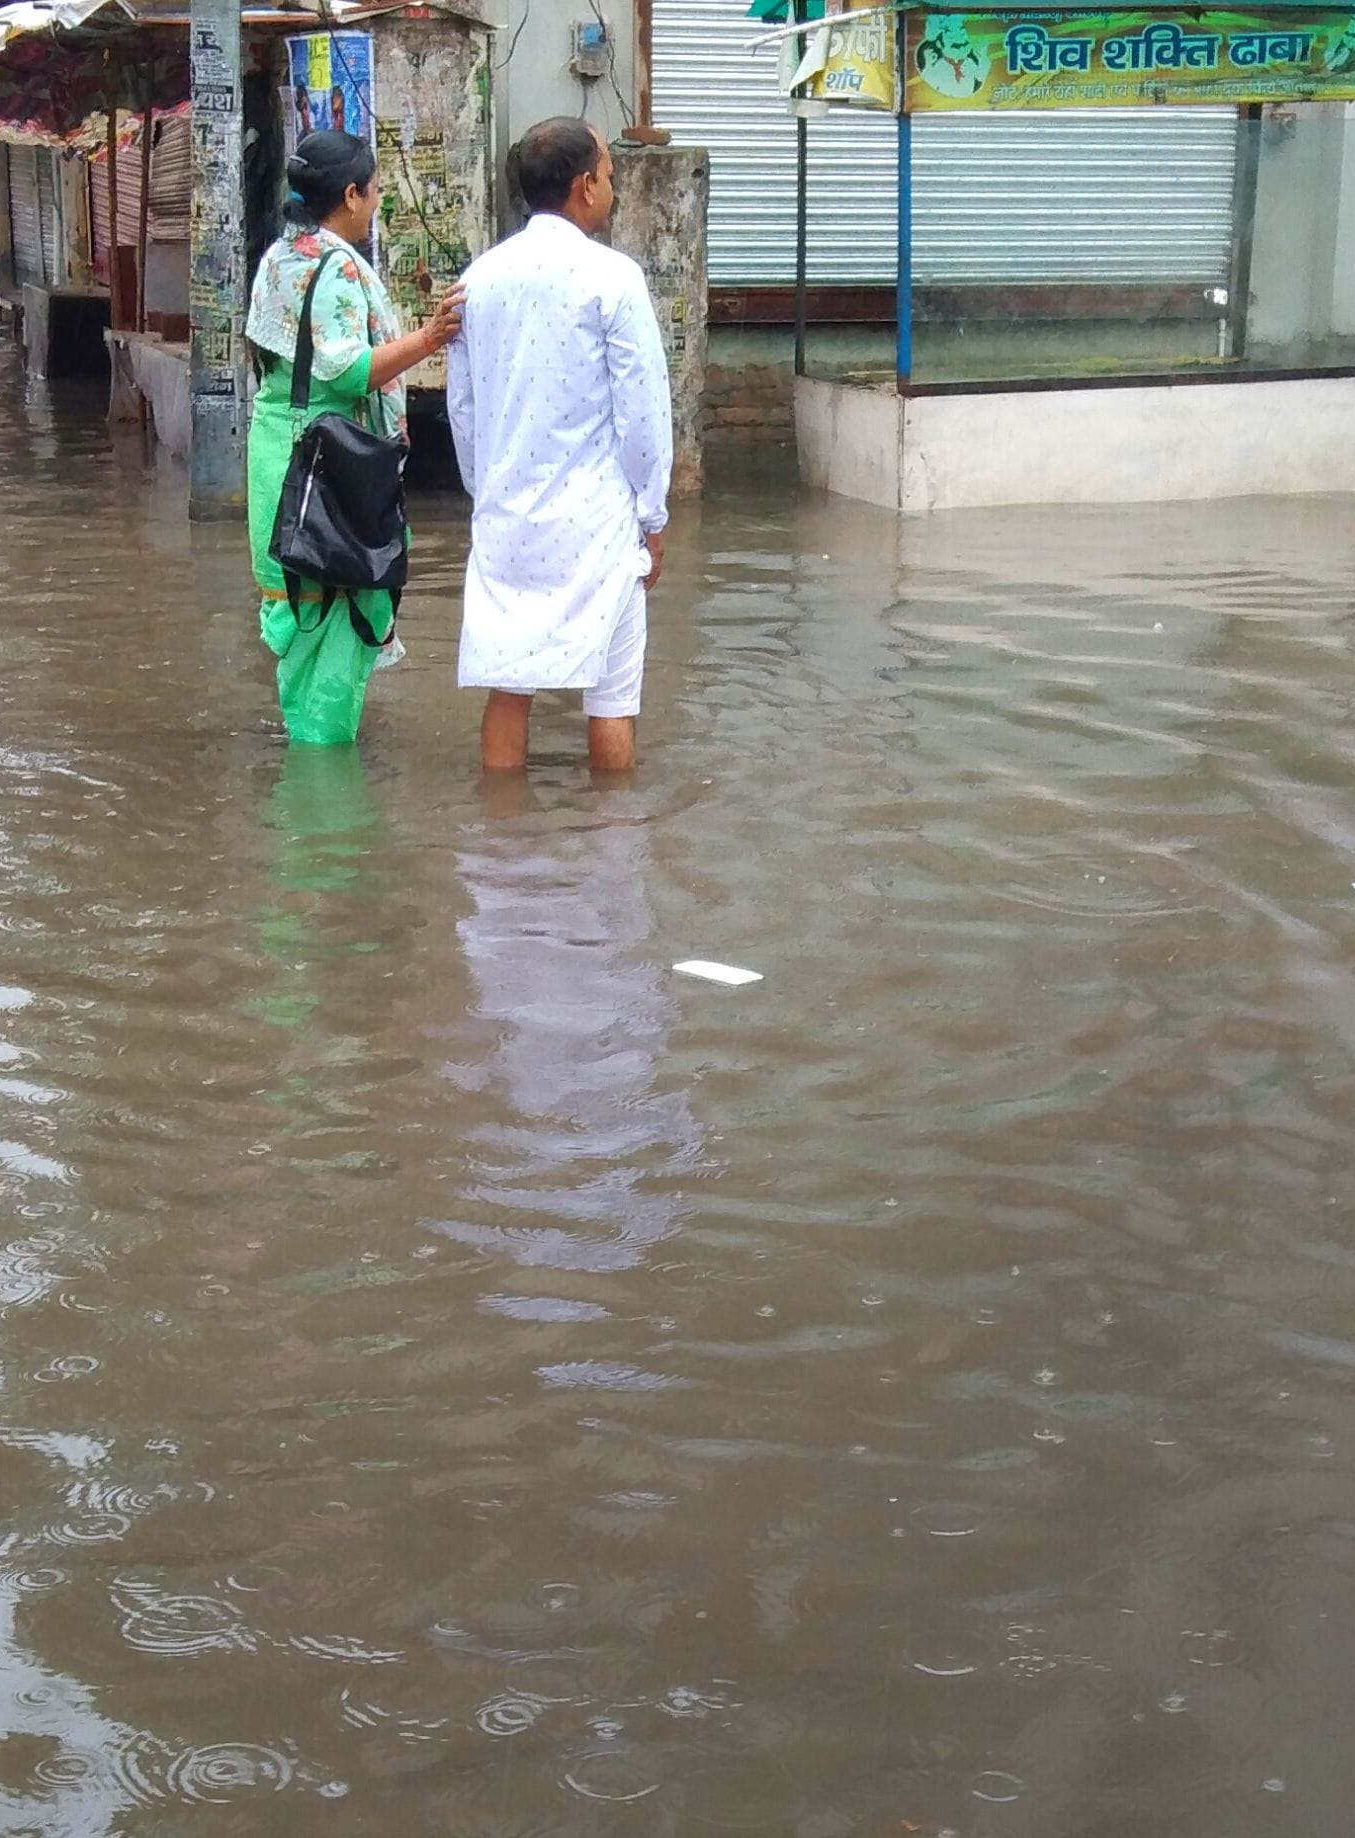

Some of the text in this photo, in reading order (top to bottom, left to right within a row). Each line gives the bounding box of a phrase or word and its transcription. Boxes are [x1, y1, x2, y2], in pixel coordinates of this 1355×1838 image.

[1005, 22, 1316, 74] शिव शक्ति ढाबा
[826, 68, 865, 91] शॉप
